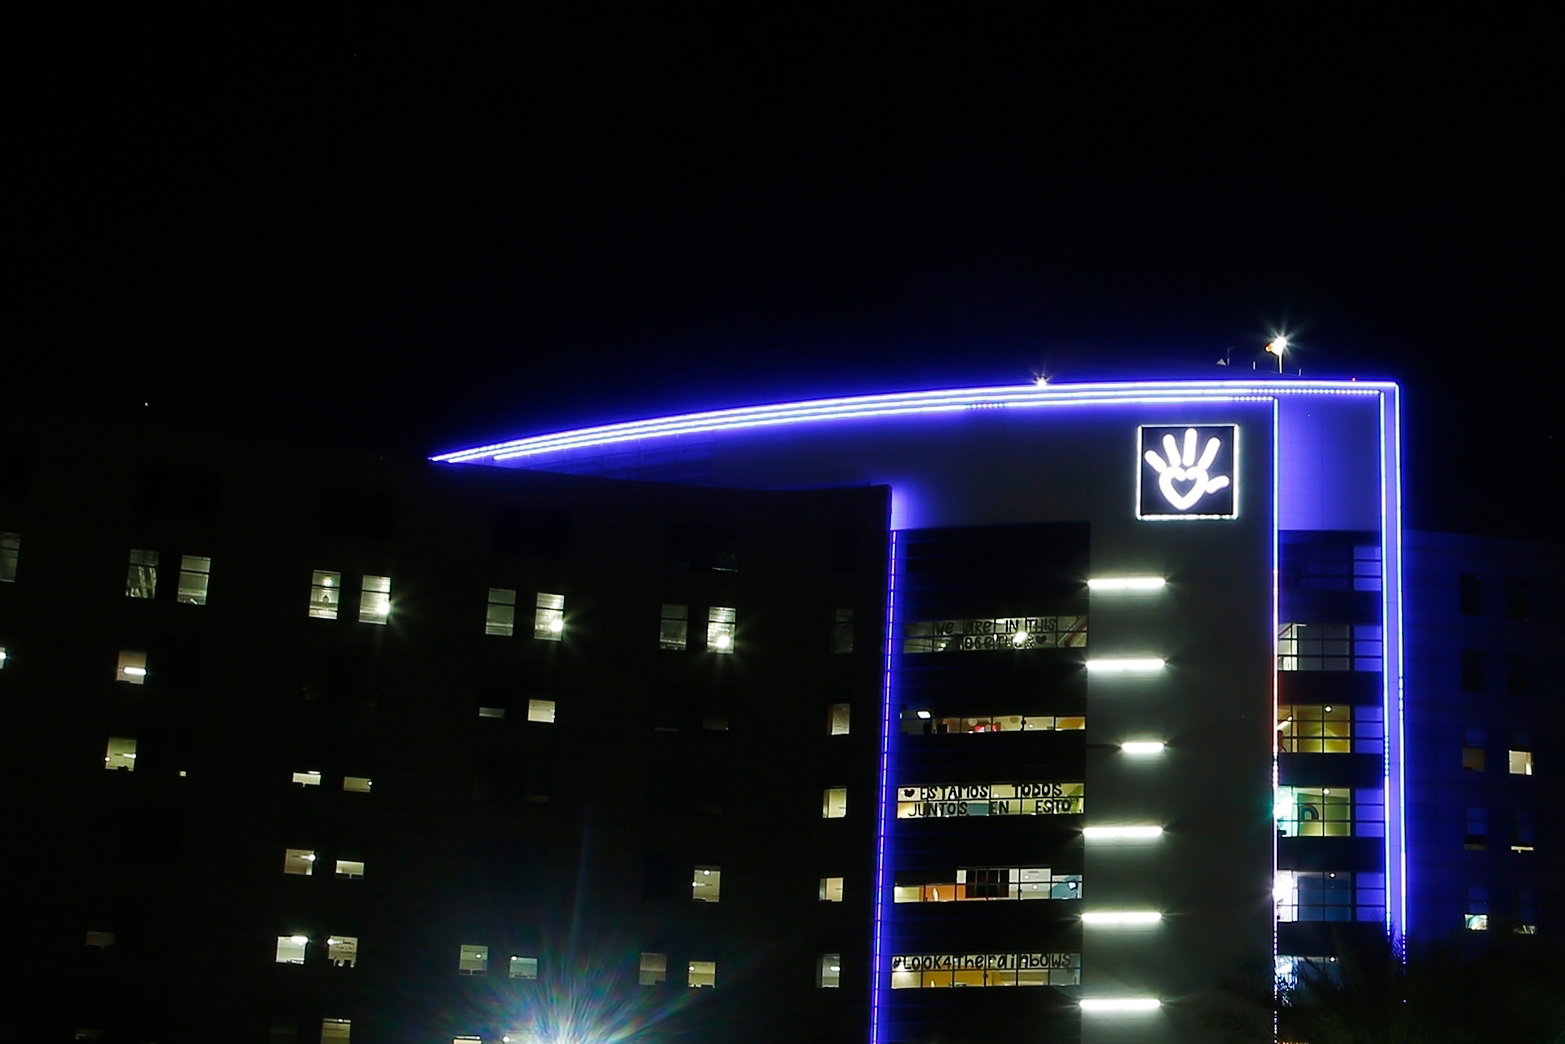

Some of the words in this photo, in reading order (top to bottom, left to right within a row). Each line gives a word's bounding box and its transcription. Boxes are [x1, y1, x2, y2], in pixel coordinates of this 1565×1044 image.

[1005, 619, 1019, 633] IN
[1027, 617, 1056, 632] THIS
[920, 785, 989, 799] ESTAMOS
[1012, 783, 1062, 798] TODOS
[908, 801, 968, 816] JUNTOS
[991, 801, 1009, 815] EN
[1035, 799, 1072, 814] ESTO
